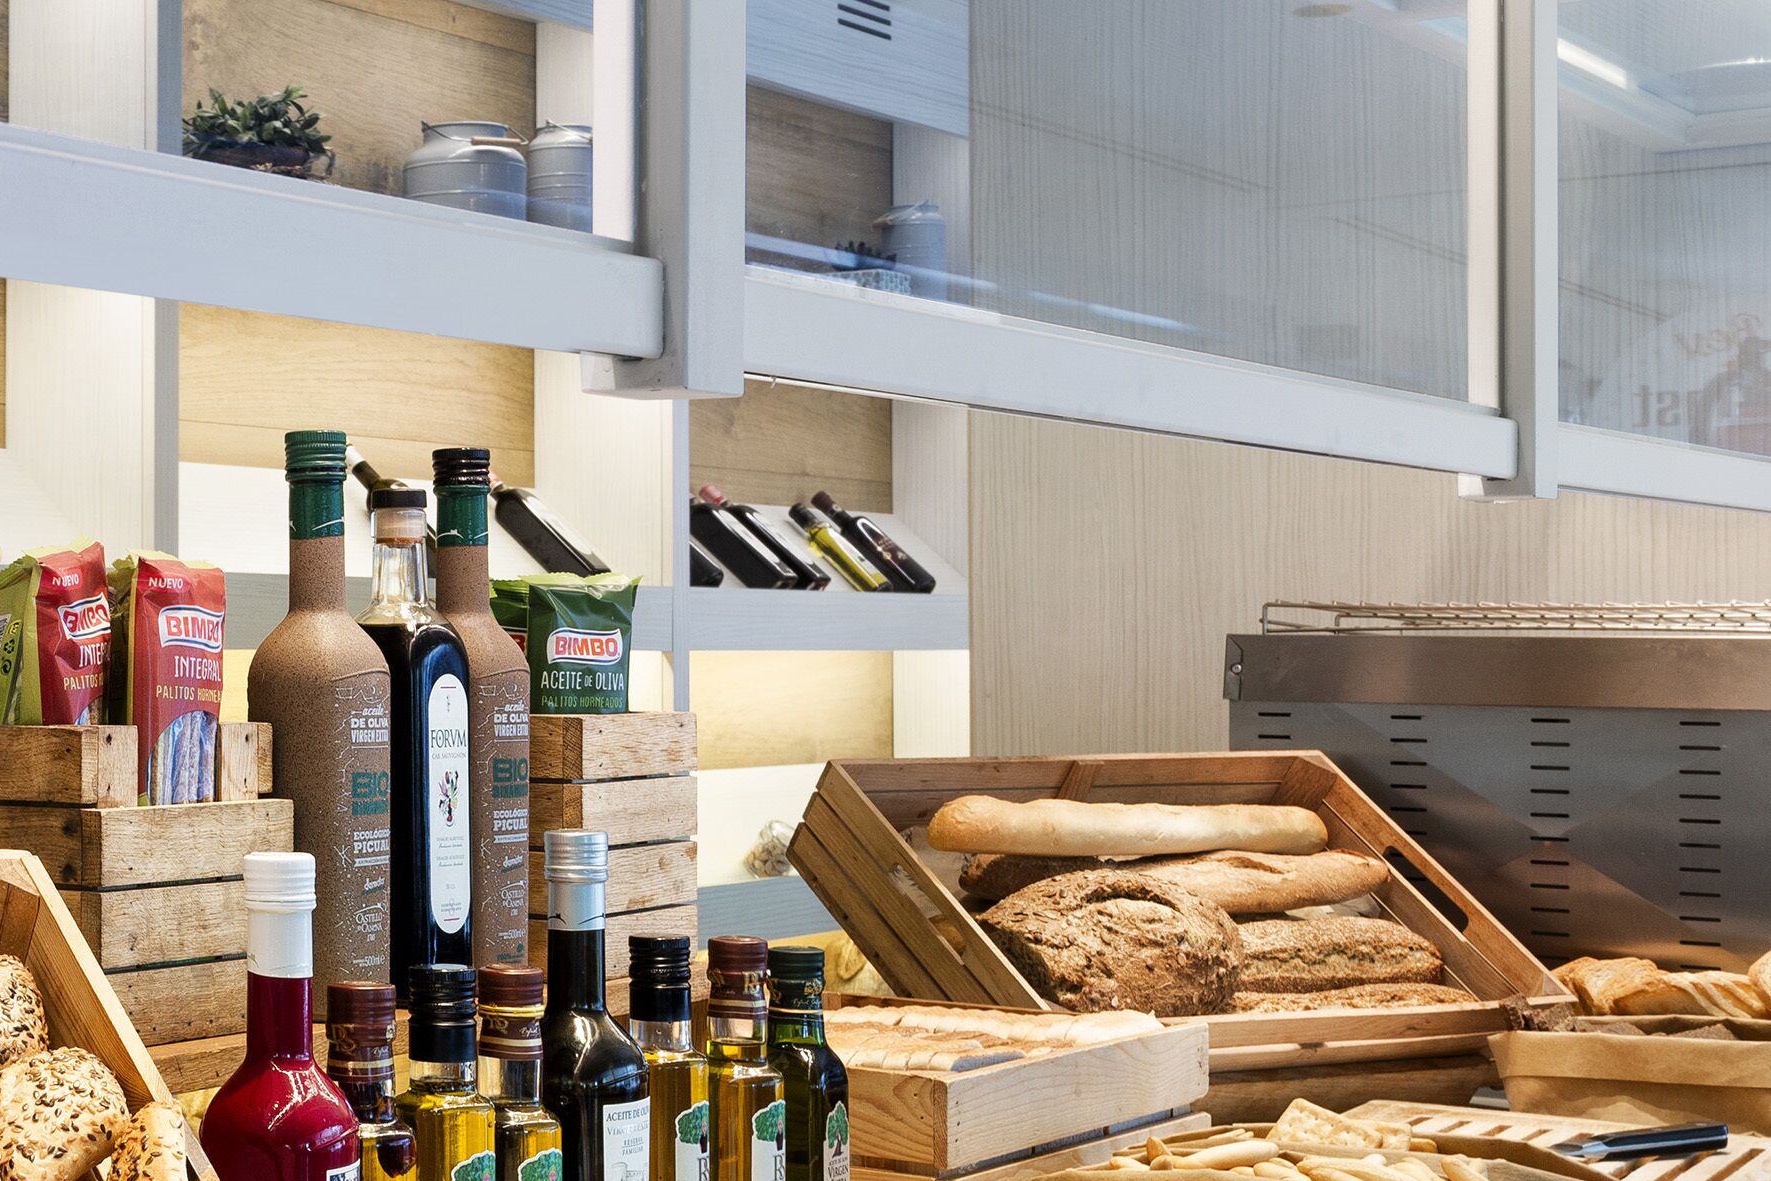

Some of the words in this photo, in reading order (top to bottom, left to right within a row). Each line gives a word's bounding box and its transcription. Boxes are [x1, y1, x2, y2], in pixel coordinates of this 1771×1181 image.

[51, 573, 80, 588] NUEVO
[148, 576, 184, 590] NUEVO
[165, 614, 220, 643] BIMBO
[554, 636, 619, 657] BIMBO
[174, 655, 221, 682] INTEGRAL
[63, 673, 98, 691] PALITOS
[540, 670, 583, 690] ACEITE
[584, 675, 593, 688] DE
[595, 672, 625, 691] OLIVA
[155, 684, 195, 701] PALITOS
[541, 695, 577, 708] PALITOS
[579, 696, 623, 708] HORNEADOS
[350, 718, 366, 728] DE
[493, 713, 508, 724] DE
[430, 729, 467, 748] FORVM
[492, 757, 529, 783] BIO
[352, 770, 389, 799] BIO
[492, 818, 528, 832] PICUAL
[353, 839, 390, 854] PICUAL
[606, 1110, 632, 1122] ACEITE
[632, 1108, 640, 1119] DE
[827, 1163, 849, 1179] VIRGEN
